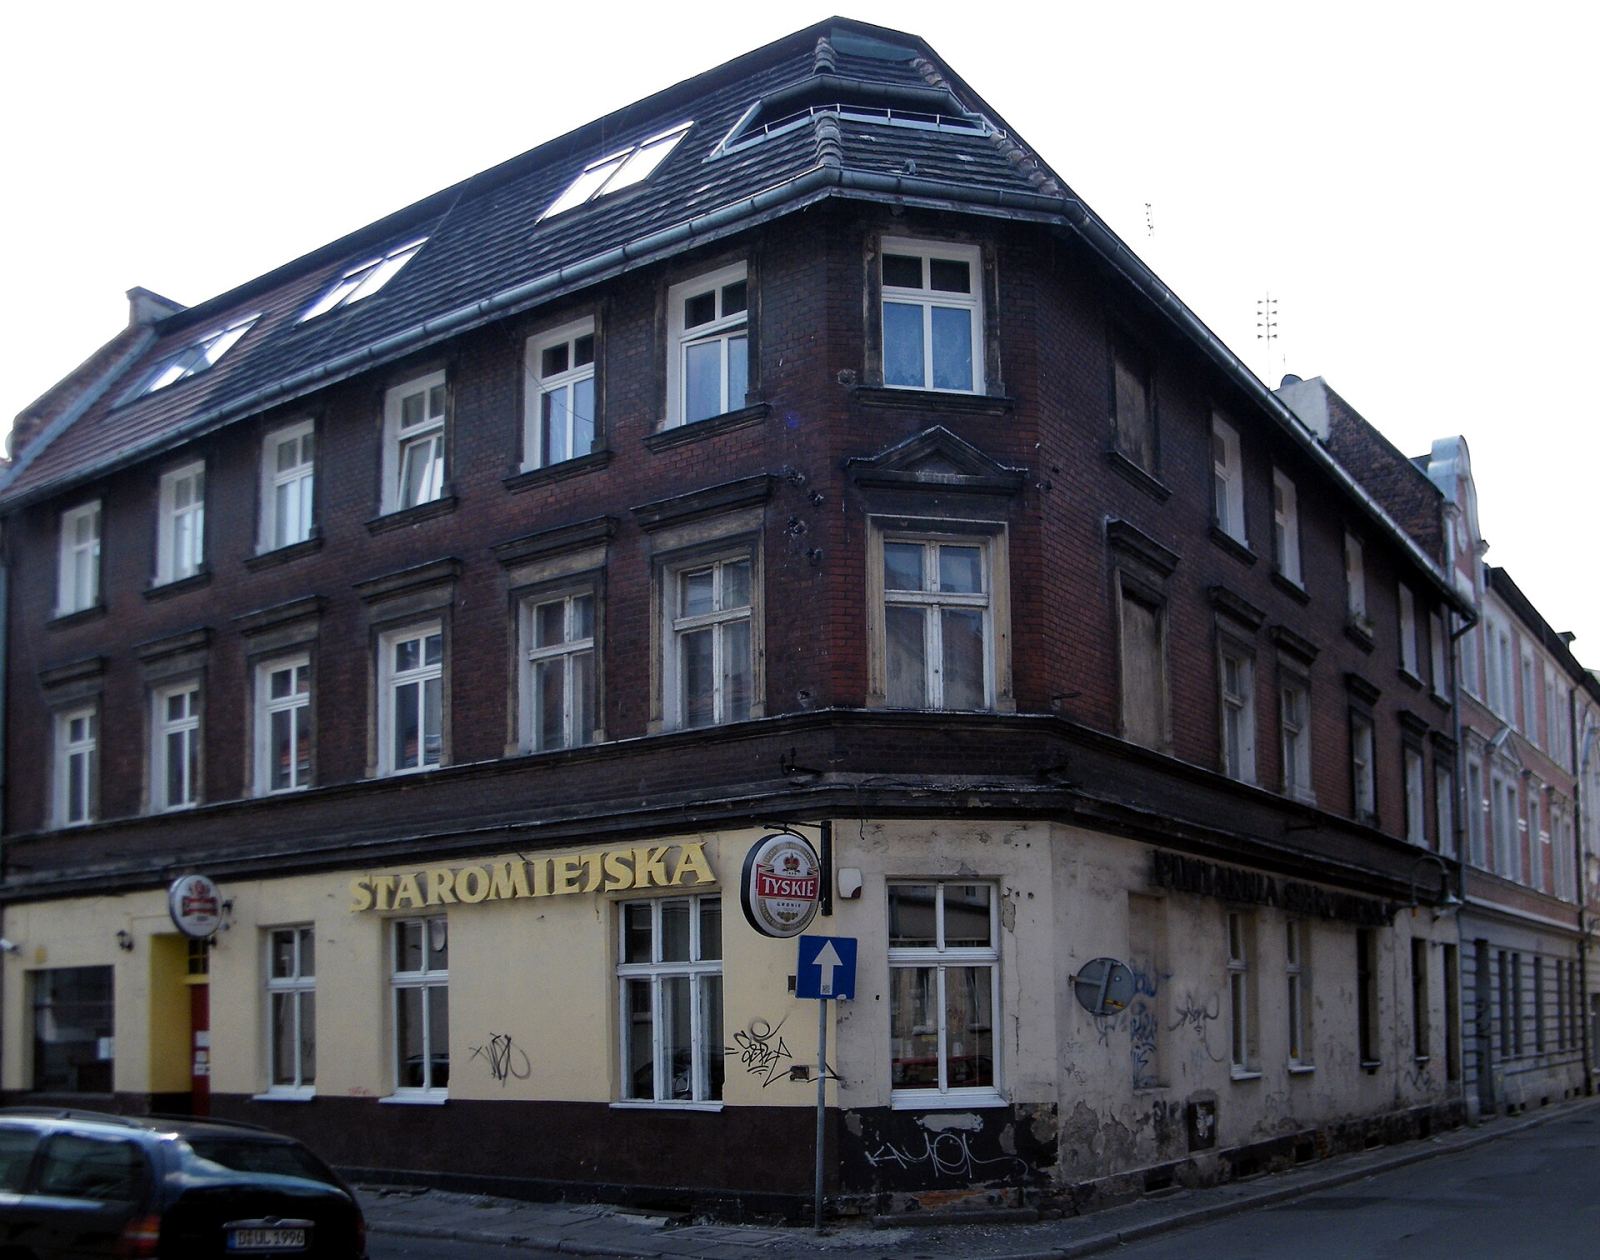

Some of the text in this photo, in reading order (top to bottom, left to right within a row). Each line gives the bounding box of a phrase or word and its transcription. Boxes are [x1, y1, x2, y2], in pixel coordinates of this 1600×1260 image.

[349, 841, 717, 912] STAROMIEJSKA
[762, 876, 814, 897] TYSKIE
[274, 1230, 304, 1245] 1996
